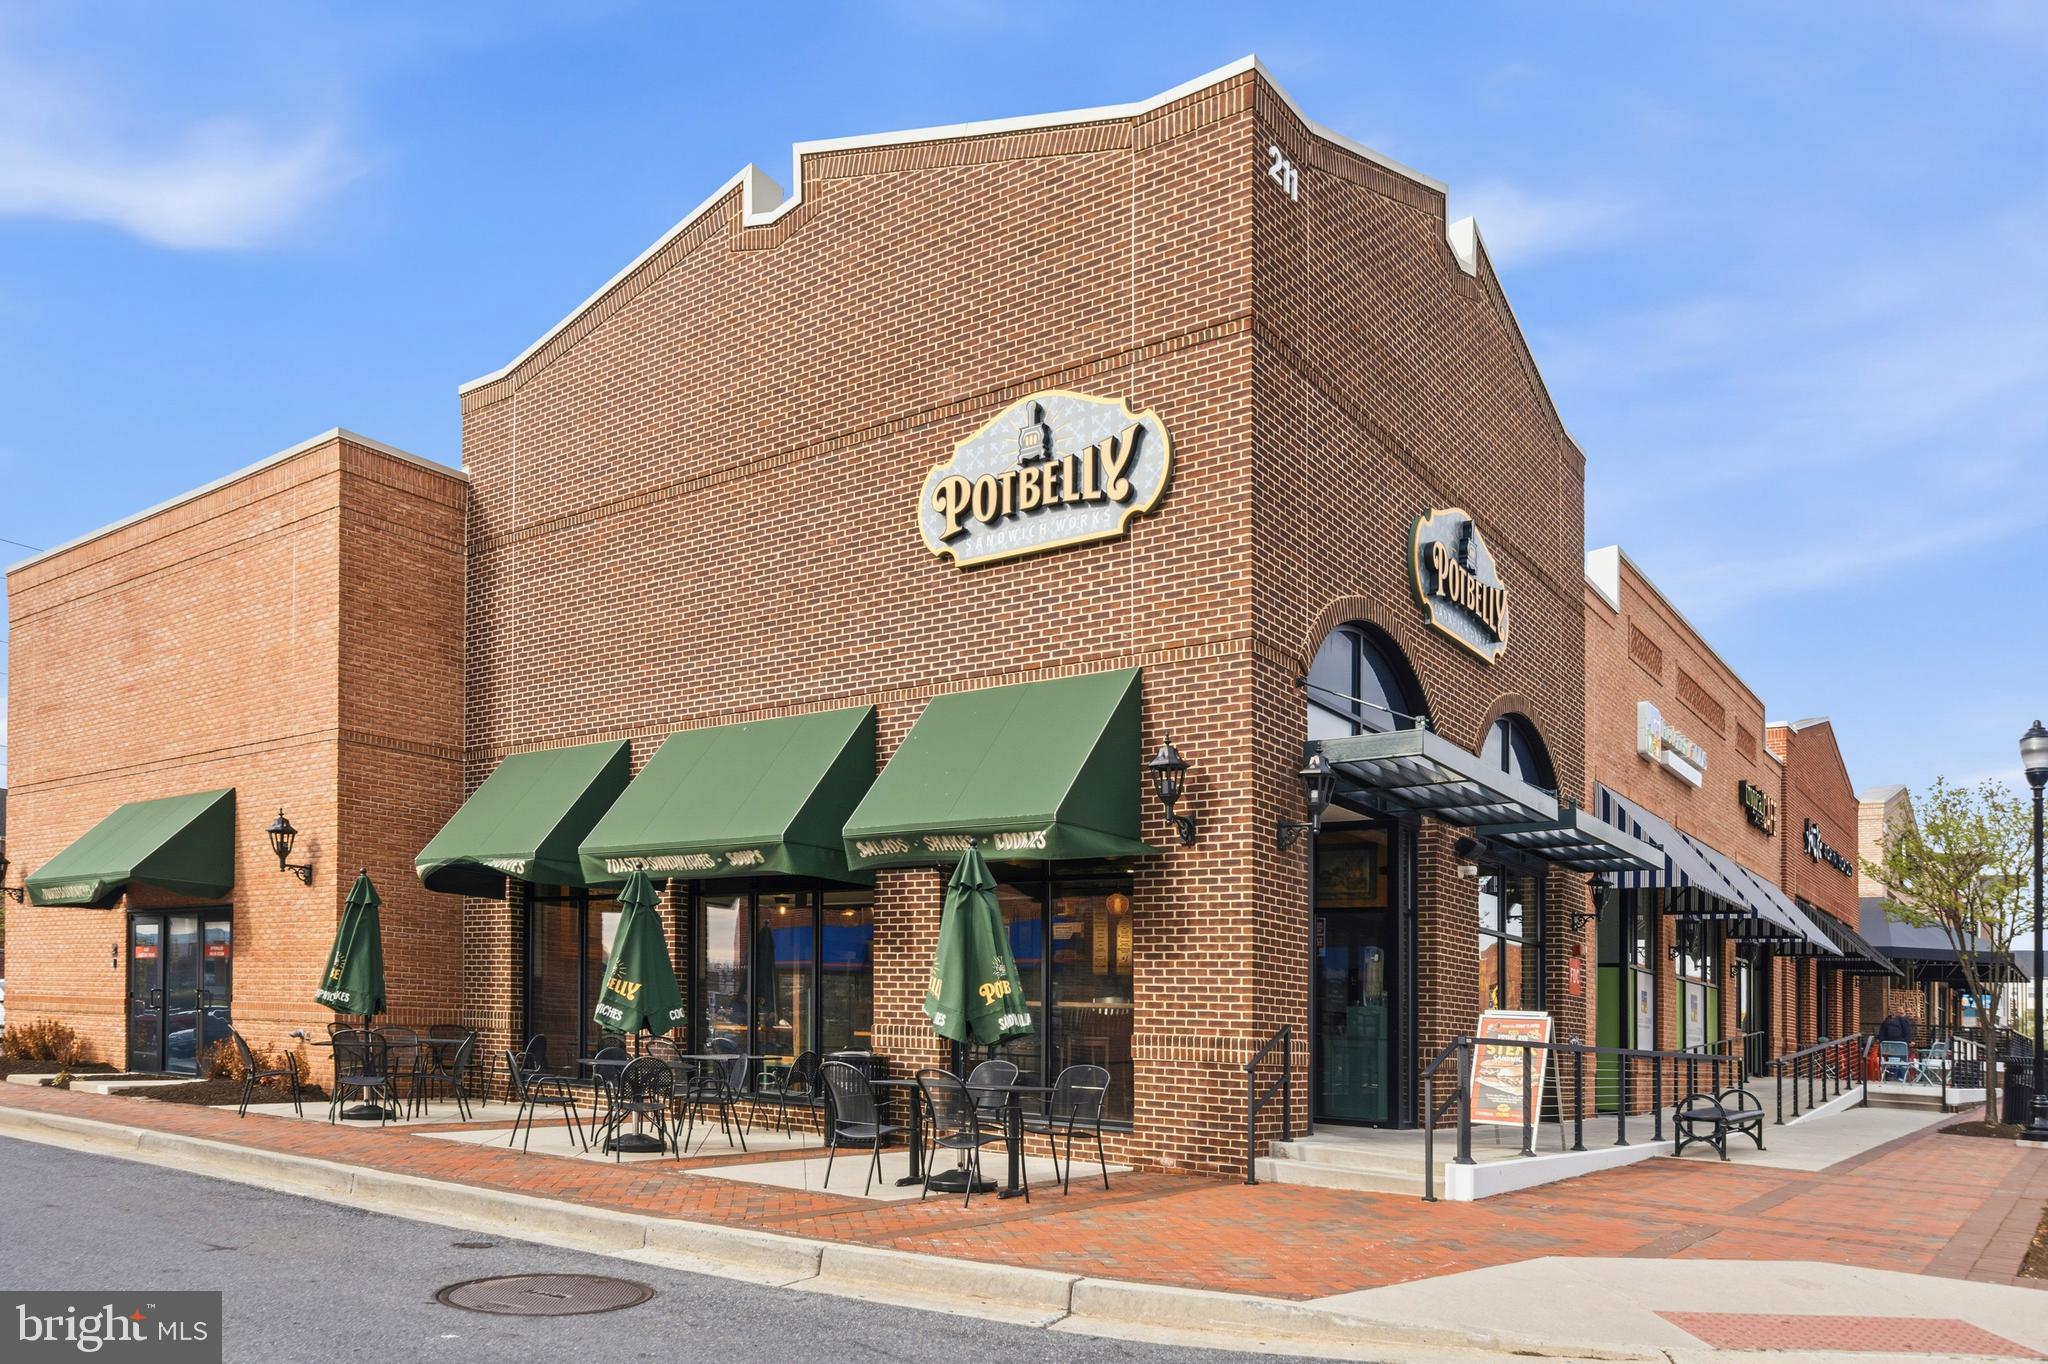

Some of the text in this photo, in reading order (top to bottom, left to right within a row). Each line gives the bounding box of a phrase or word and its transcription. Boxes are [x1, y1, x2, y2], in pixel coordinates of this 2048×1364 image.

[1268, 145, 1298, 203] 211
[931, 422, 1143, 542] POTBELLY
[964, 510, 1112, 551] SANDWICH WORKS
[1432, 540, 1510, 643] POTBELLY
[725, 849, 765, 867] SOUPS
[856, 839, 911, 859] SALADS
[993, 830, 1047, 851] COOKIES
